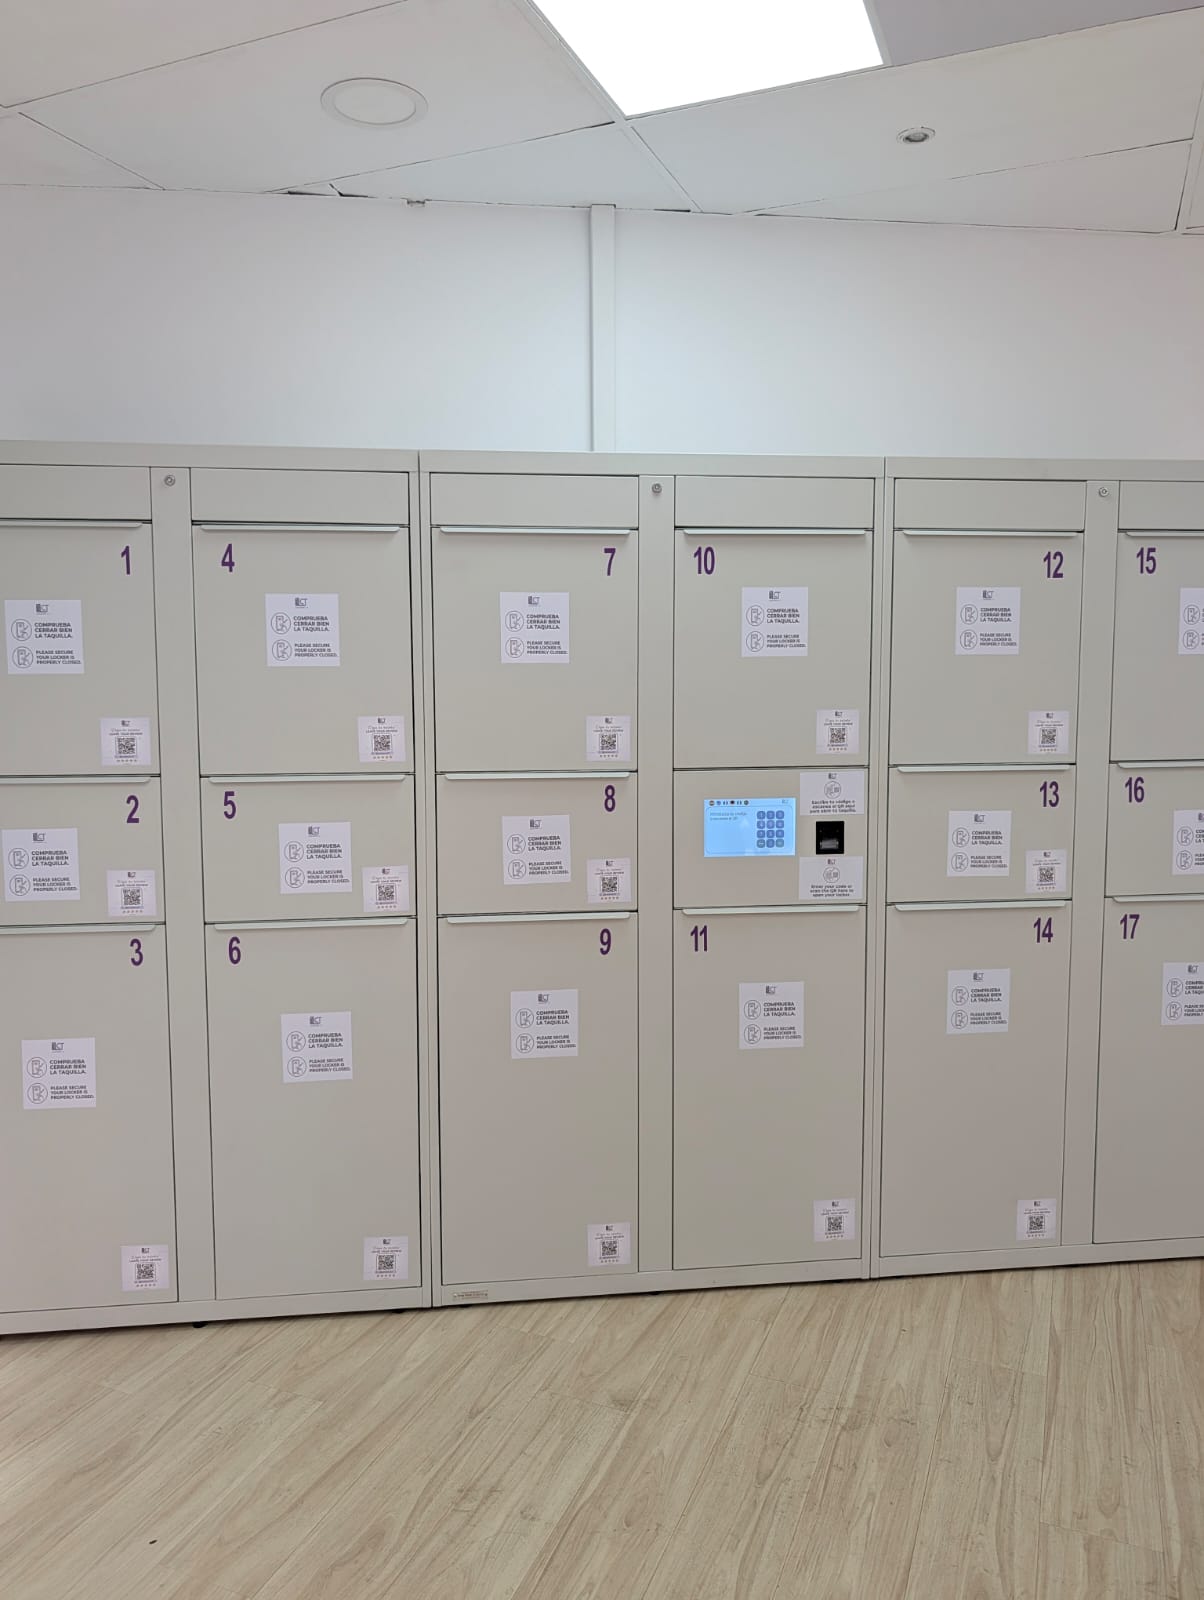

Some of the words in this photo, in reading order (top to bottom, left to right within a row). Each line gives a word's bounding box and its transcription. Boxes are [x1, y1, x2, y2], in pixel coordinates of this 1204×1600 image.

[120, 546, 130, 575] 1
[221, 544, 234, 573] 4
[603, 548, 616, 576] 7
[693, 547, 714, 575] 10
[1043, 552, 1064, 579] 12
[1136, 548, 1156, 575] 15
[604, 785, 616, 813] 8
[1039, 782, 1060, 808] 13
[1124, 777, 1144, 803] 16
[126, 795, 140, 824] 2
[223, 791, 236, 820] 5
[689, 926, 708, 952] 11
[1033, 918, 1054, 943] 14
[1119, 914, 1140, 940] 17
[129, 939, 144, 967] 3
[228, 937, 242, 965] 6
[599, 929, 612, 956] 9
